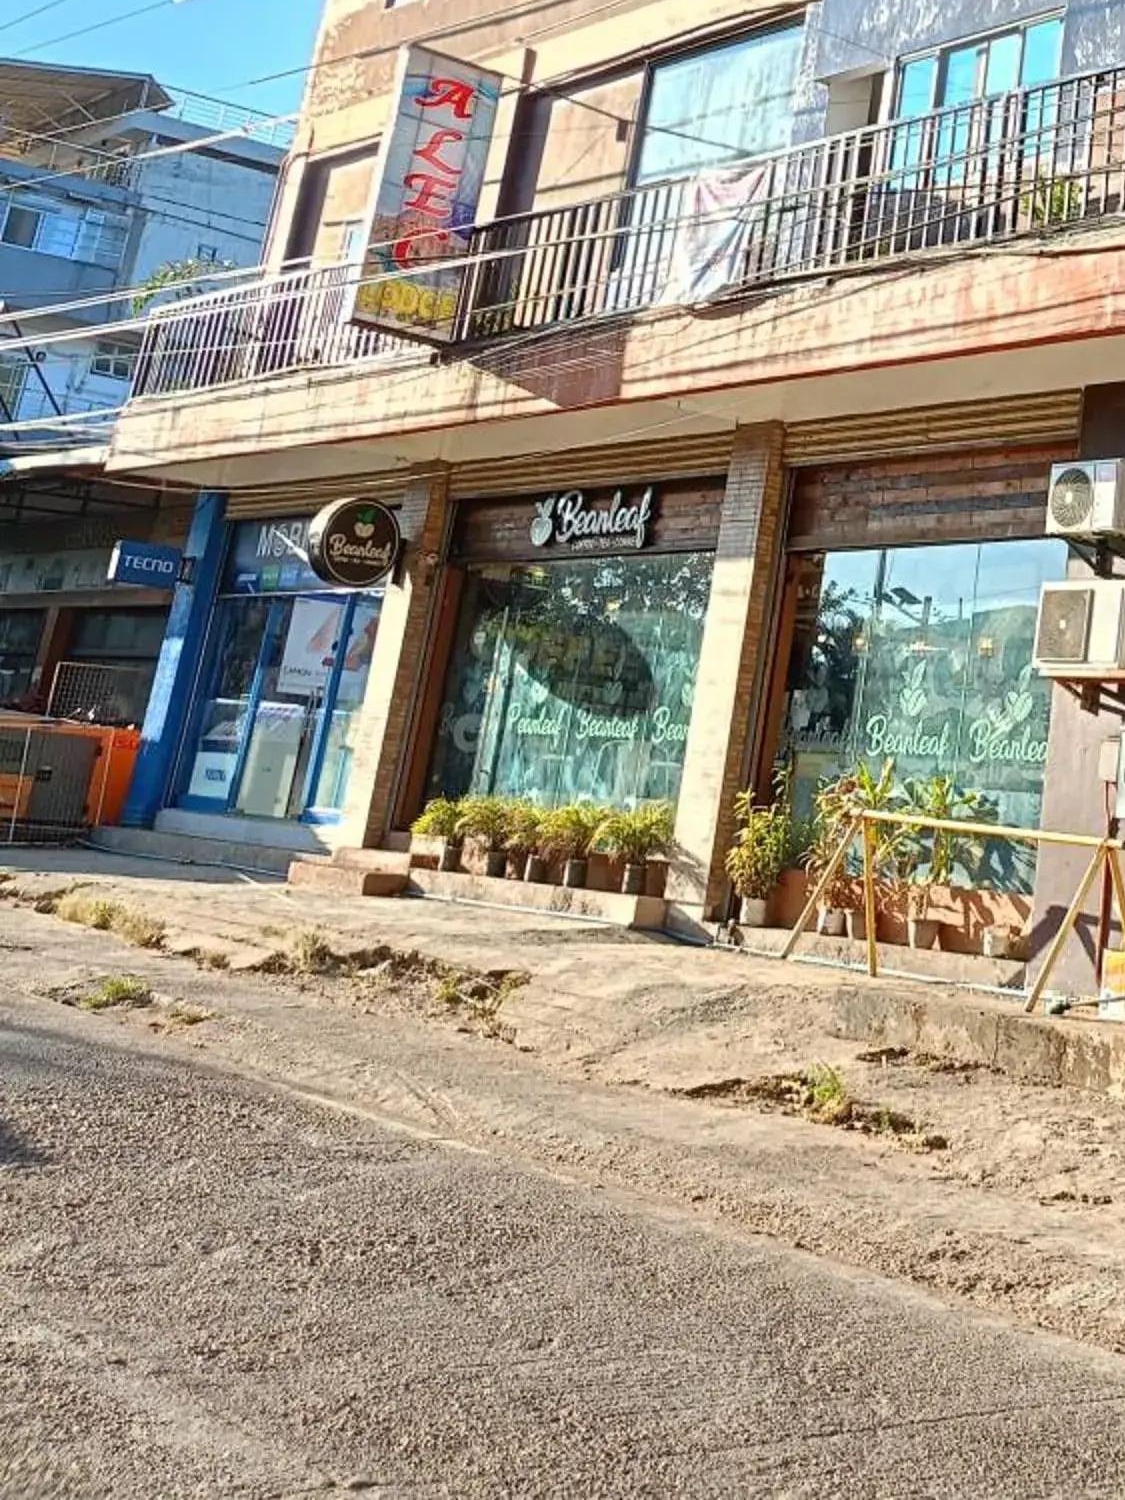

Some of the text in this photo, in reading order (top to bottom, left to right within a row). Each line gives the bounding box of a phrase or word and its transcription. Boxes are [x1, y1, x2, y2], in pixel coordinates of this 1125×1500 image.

[393, 78, 477, 270] ALEC
[555, 486, 653, 549] Beanleaf
[125, 555, 174, 573] TECNO
[329, 533, 392, 566] Beanleaf
[866, 714, 950, 770] Beanleaf
